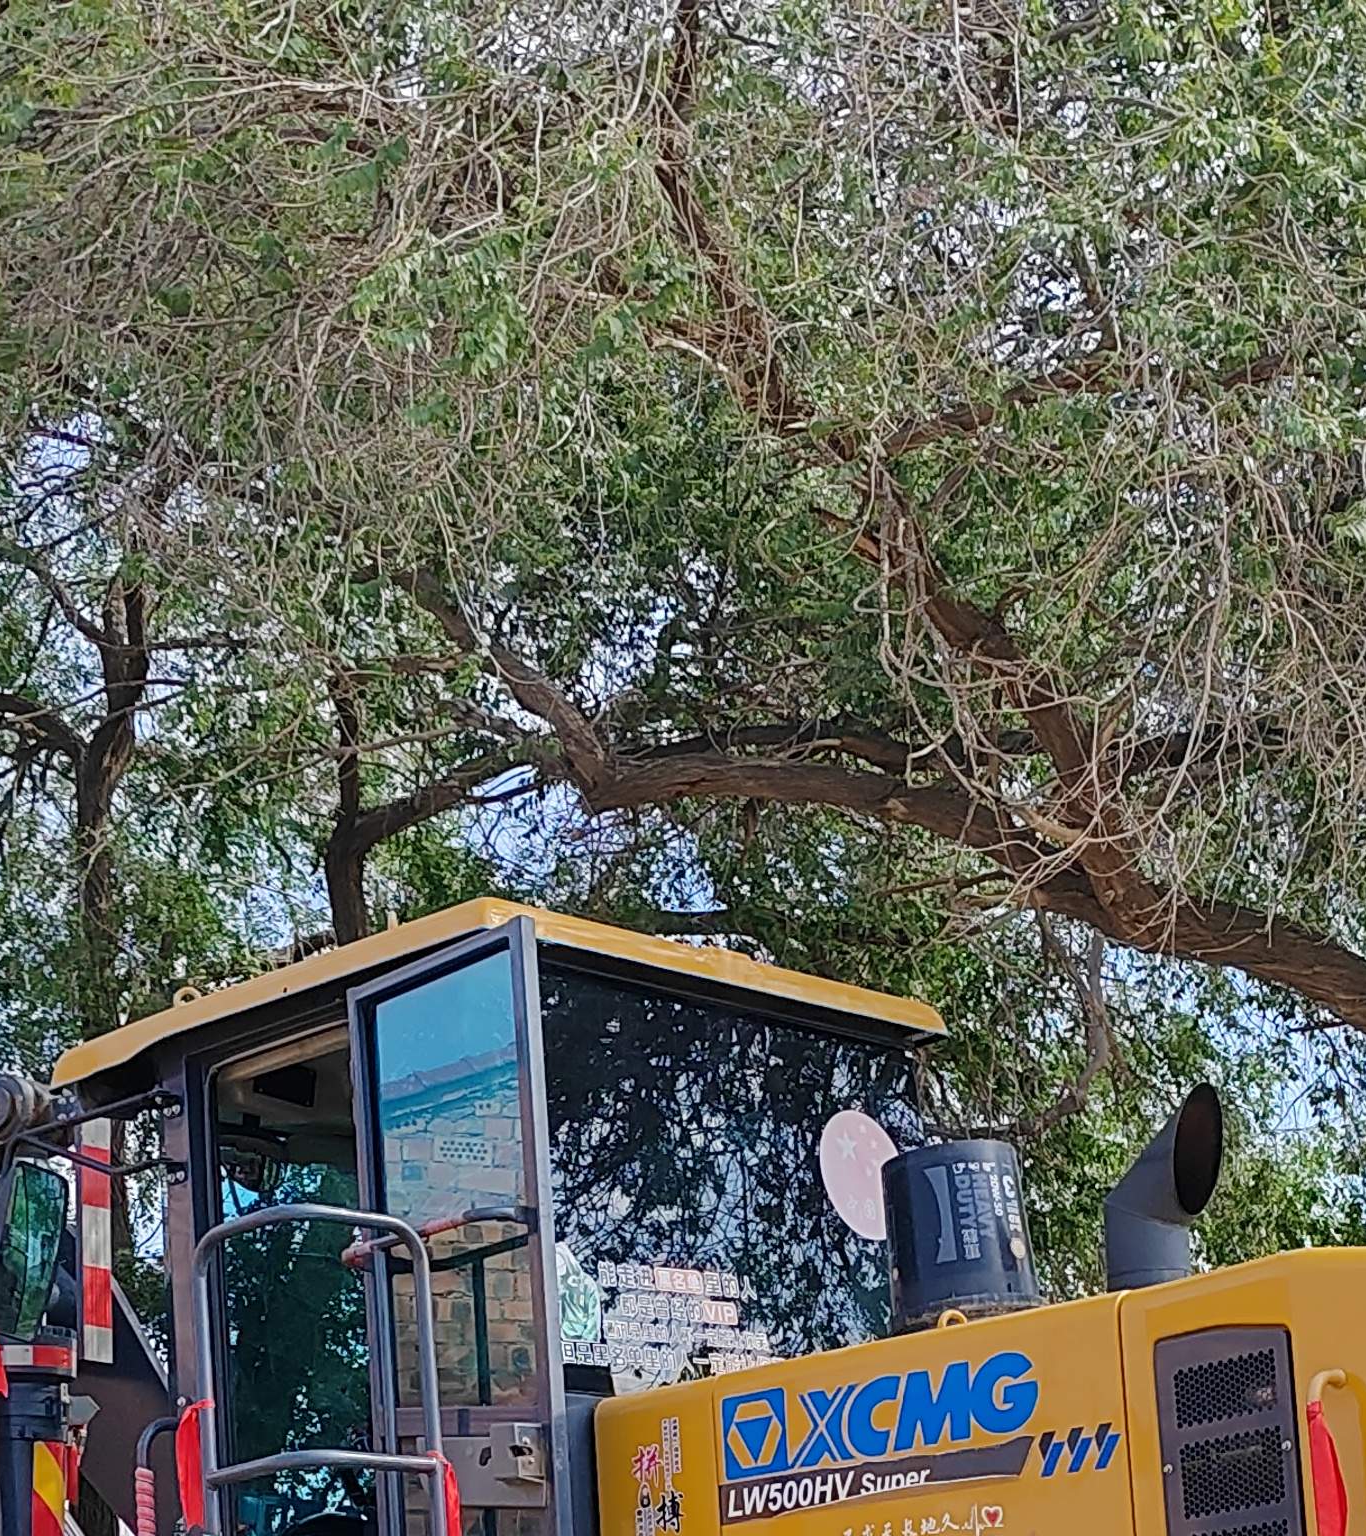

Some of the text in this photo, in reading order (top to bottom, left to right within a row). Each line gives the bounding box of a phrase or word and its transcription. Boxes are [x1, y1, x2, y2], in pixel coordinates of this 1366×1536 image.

[788, 1351, 1039, 1470] XCMG
[727, 1468, 931, 1519] LW500HV Super
